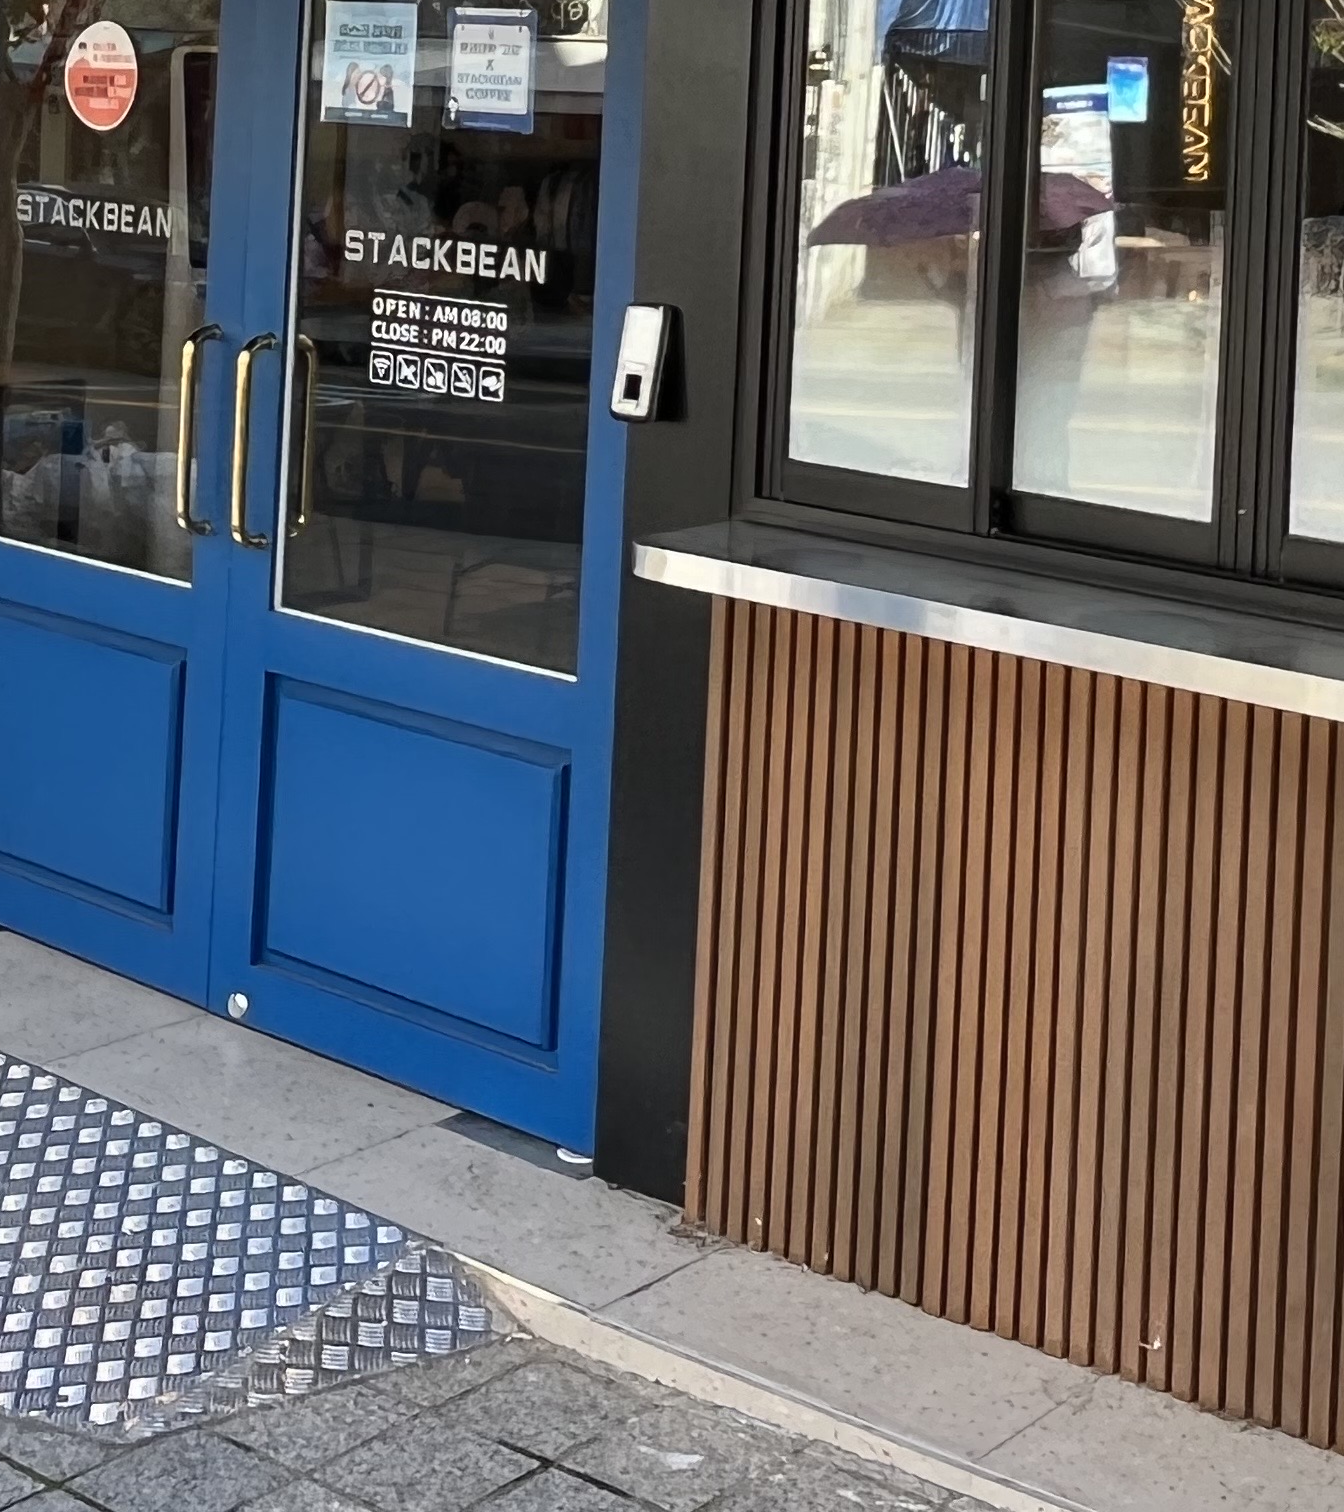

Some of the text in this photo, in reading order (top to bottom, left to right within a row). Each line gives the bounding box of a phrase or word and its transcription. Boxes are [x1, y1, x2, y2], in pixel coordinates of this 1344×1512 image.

[17, 194, 173, 238] STACKBEAN
[344, 229, 547, 285] STACKBEAN
[372, 297, 421, 320] OPEN
[433, 305, 458, 325] AM
[461, 308, 508, 331] 08:00
[371, 320, 419, 344] CLOSE
[459, 332, 506, 355] 22:00
